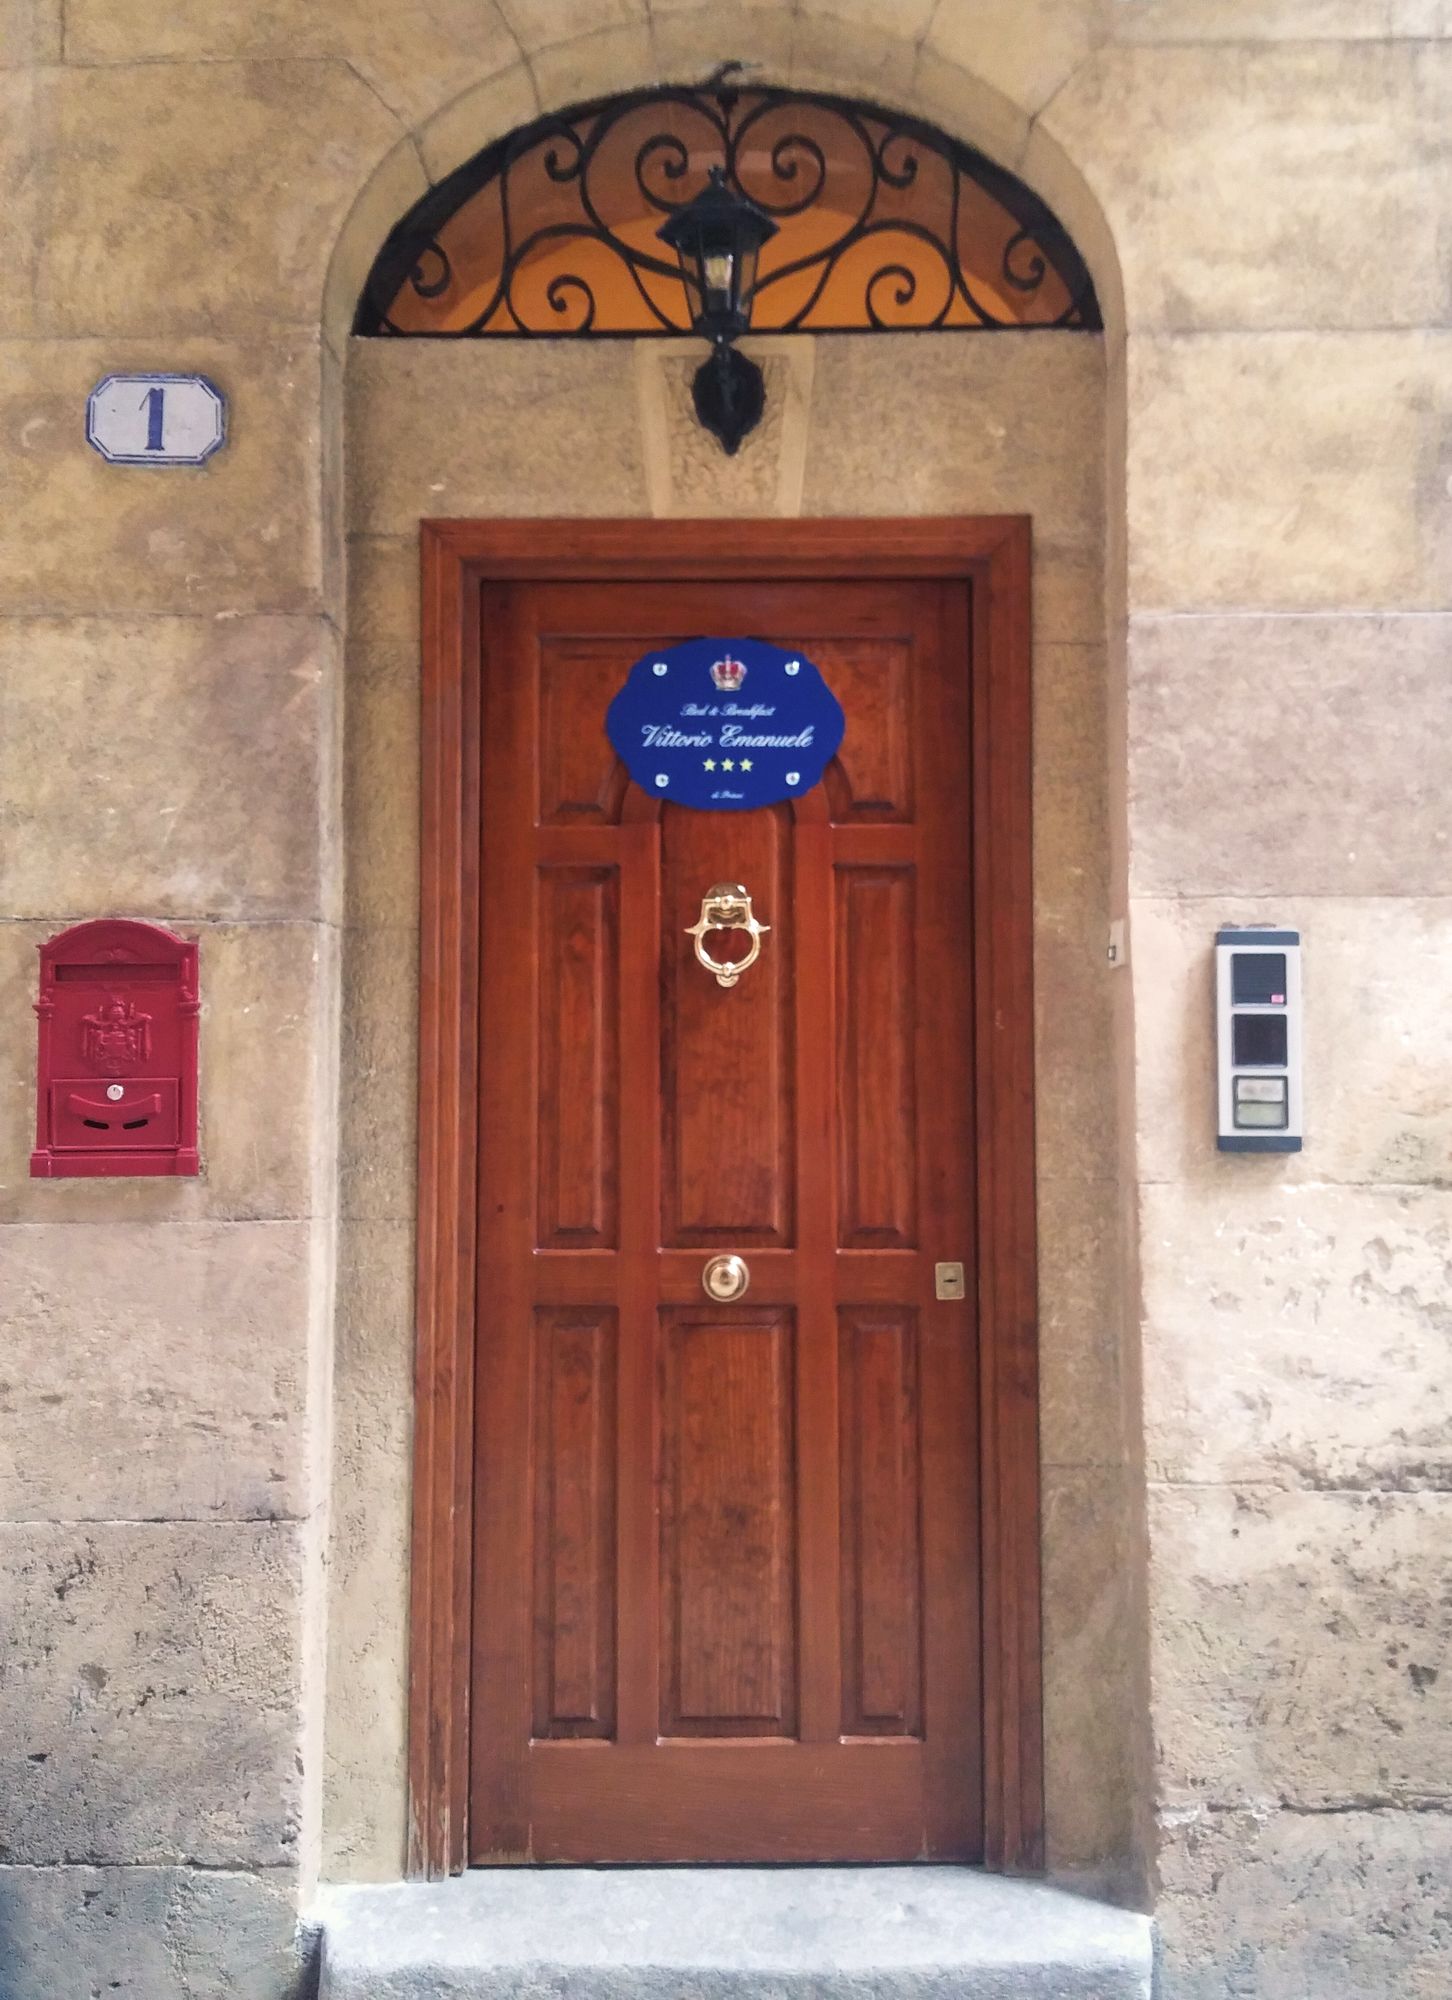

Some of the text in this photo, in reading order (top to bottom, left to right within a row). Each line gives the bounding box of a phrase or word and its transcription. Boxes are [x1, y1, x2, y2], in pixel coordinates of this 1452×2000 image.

[139, 387, 165, 450] 1
[680, 703, 710, 716] Bed
[720, 703, 776, 720] Breakfast
[641, 724, 815, 748] Vittorio Emanuele
